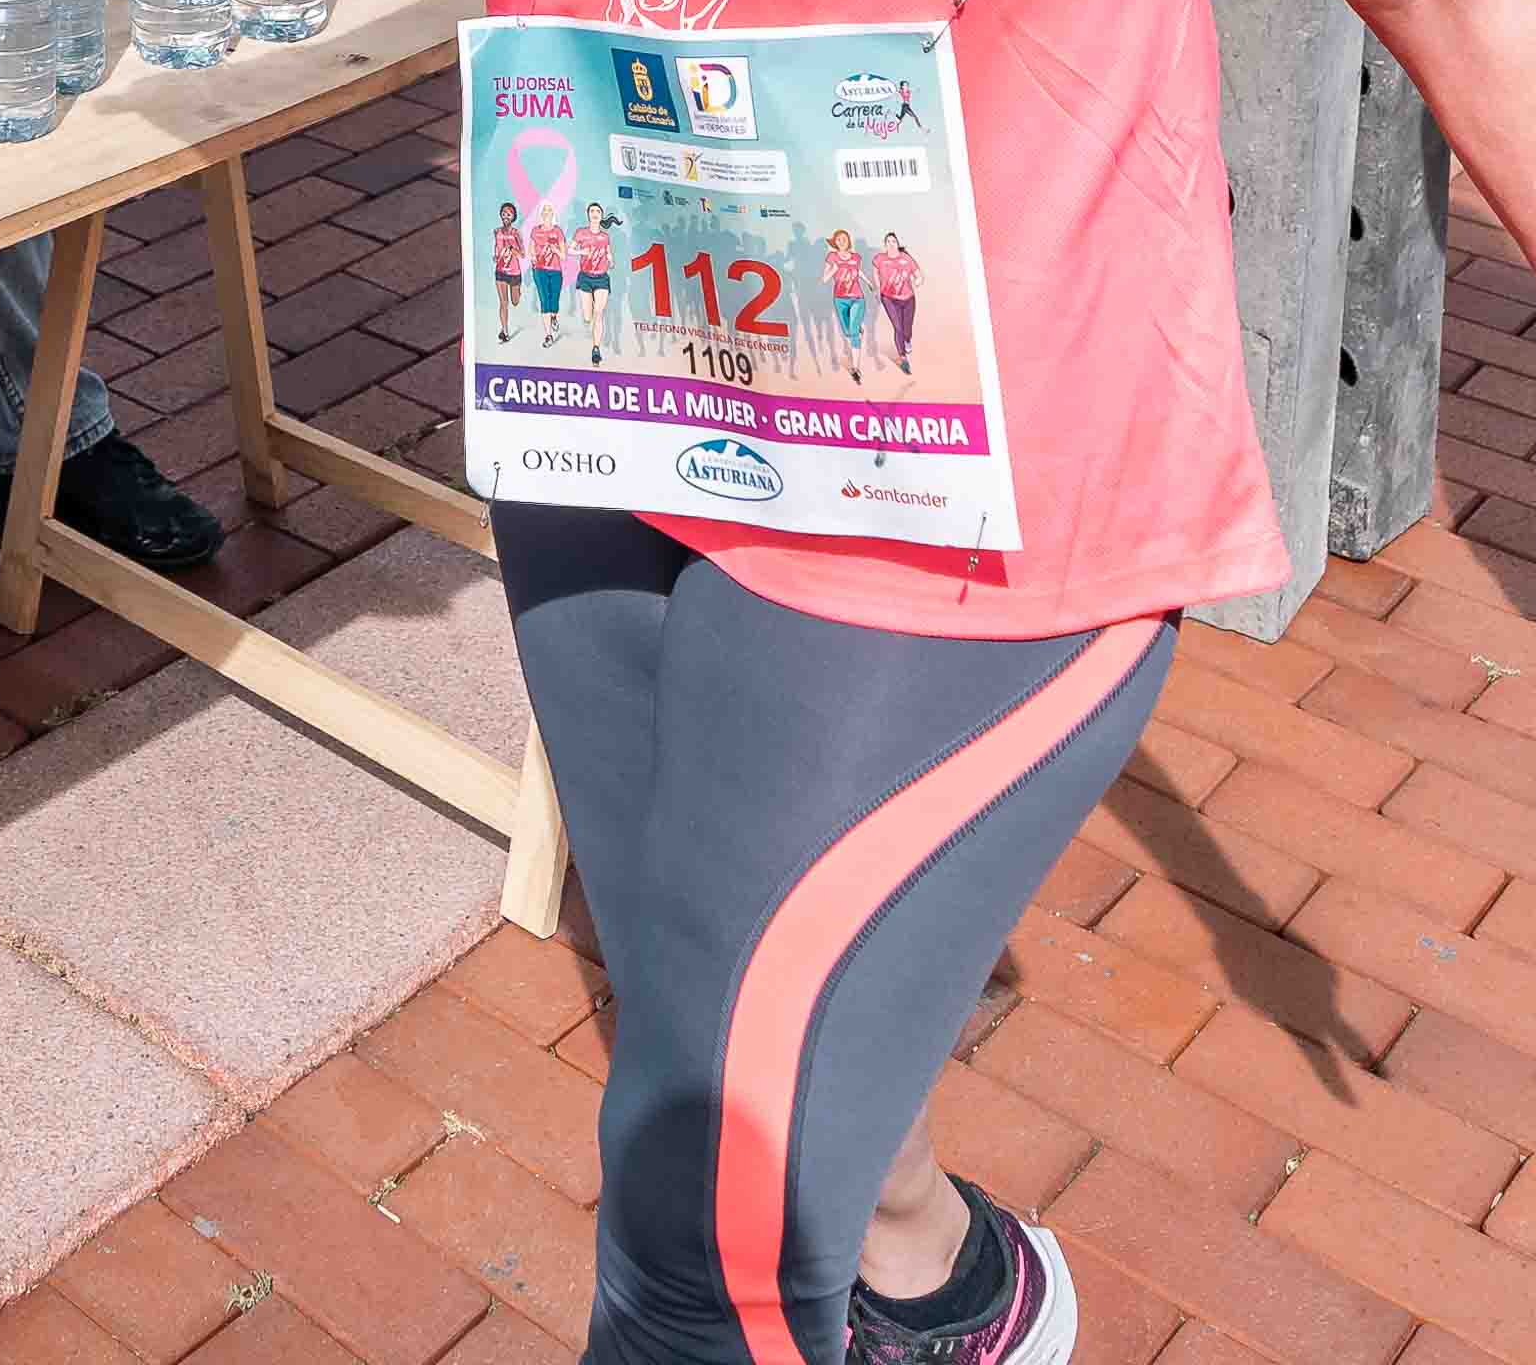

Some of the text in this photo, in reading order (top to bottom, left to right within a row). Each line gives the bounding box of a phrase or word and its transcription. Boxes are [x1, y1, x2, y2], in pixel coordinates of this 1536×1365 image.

[493, 76, 575, 92] TU DORSAL
[841, 84, 893, 97] ASTURIANA
[494, 93, 575, 119] SUMA
[831, 101, 884, 118] Carrera
[631, 243, 790, 337] 112
[682, 341, 753, 386] 1109
[487, 376, 969, 447] CARRERA DE LA MUJER GRAN CANARIA
[522, 448, 617, 477] OYSHO
[685, 454, 776, 493] ASTURIANA
[863, 484, 949, 509] Santander
